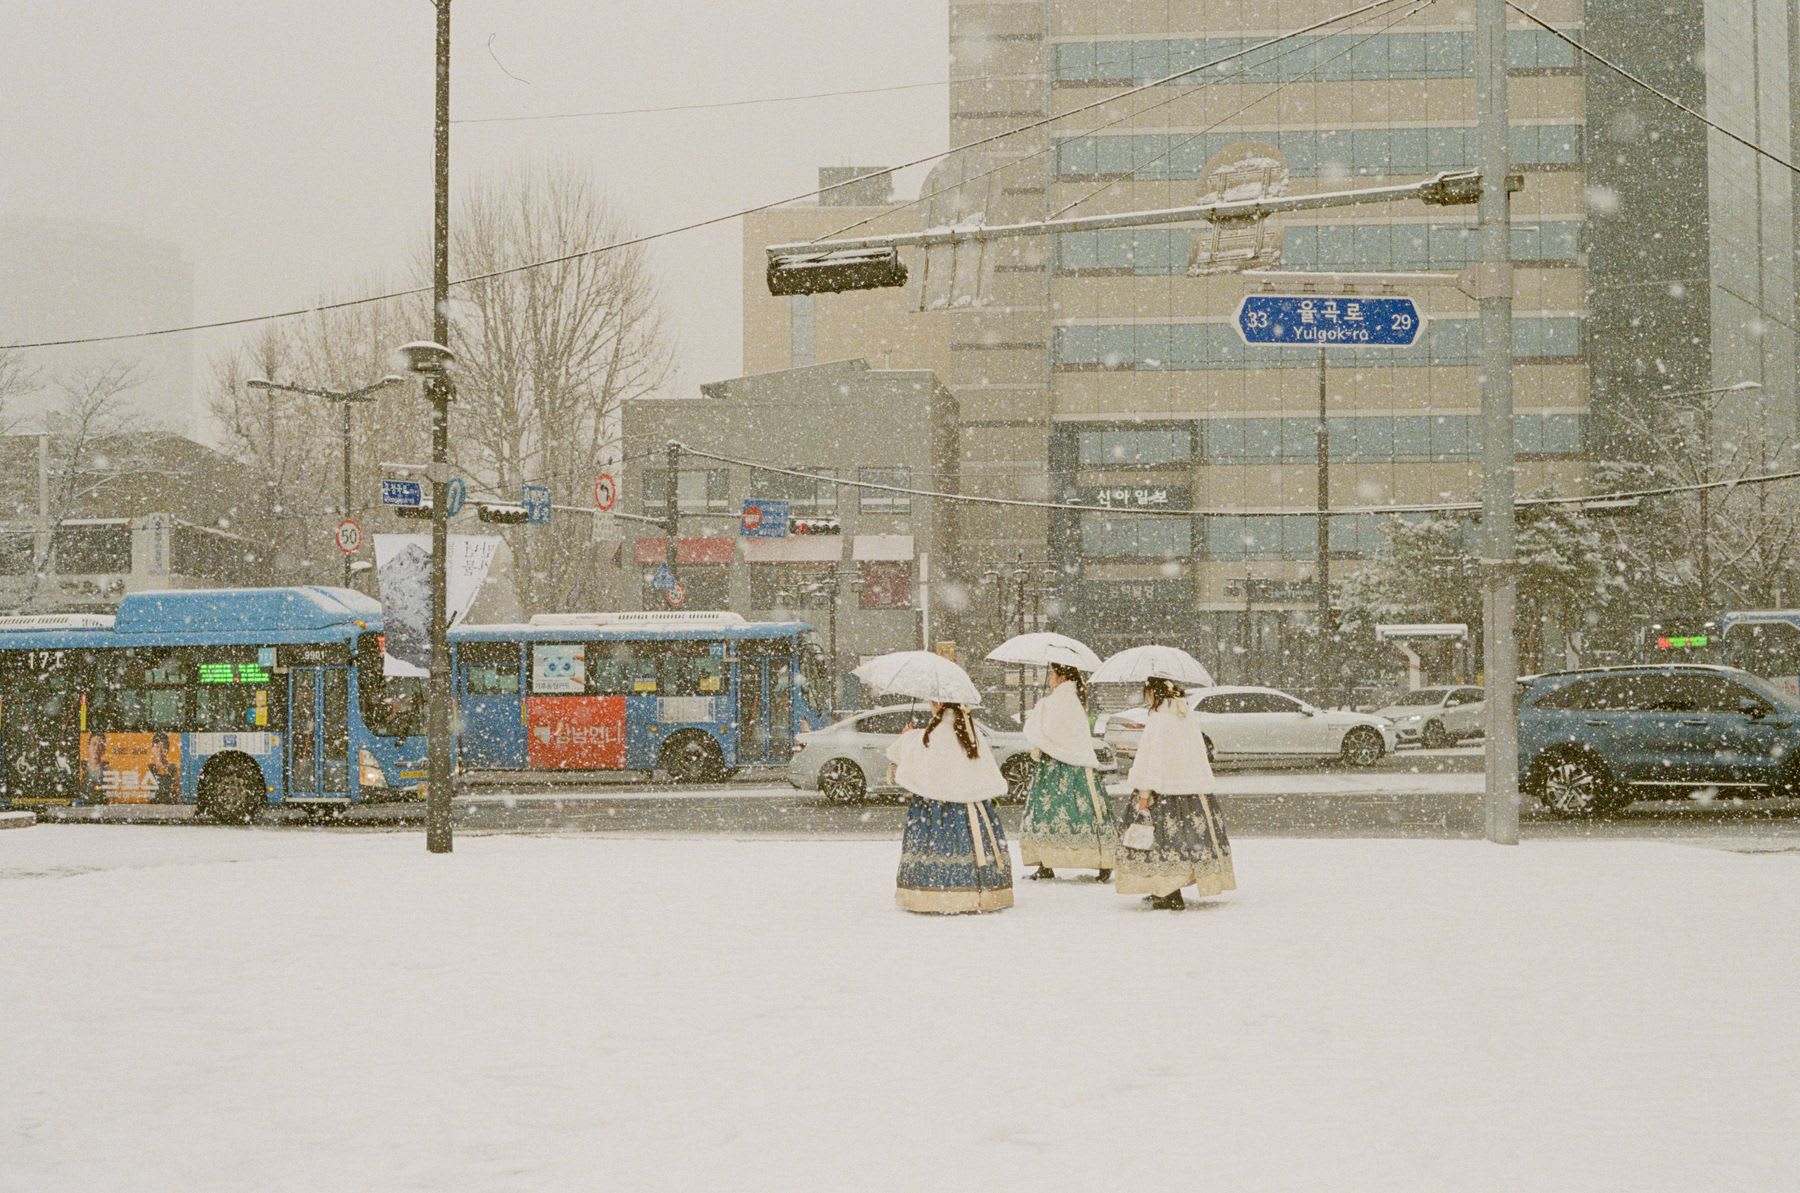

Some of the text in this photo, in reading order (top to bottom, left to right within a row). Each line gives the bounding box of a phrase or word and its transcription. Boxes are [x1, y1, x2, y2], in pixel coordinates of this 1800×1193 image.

[1247, 312, 1268, 328] 33
[1297, 300, 1364, 324] 율곡로
[1391, 314, 1412, 331] 29
[1293, 325, 1369, 342] Yulgok-ro
[1096, 489, 1169, 509] 신아일보
[341, 529, 357, 545] 50
[28, 651, 65, 670] 171
[304, 650, 325, 660] 9901
[101, 769, 160, 791] 크로스
